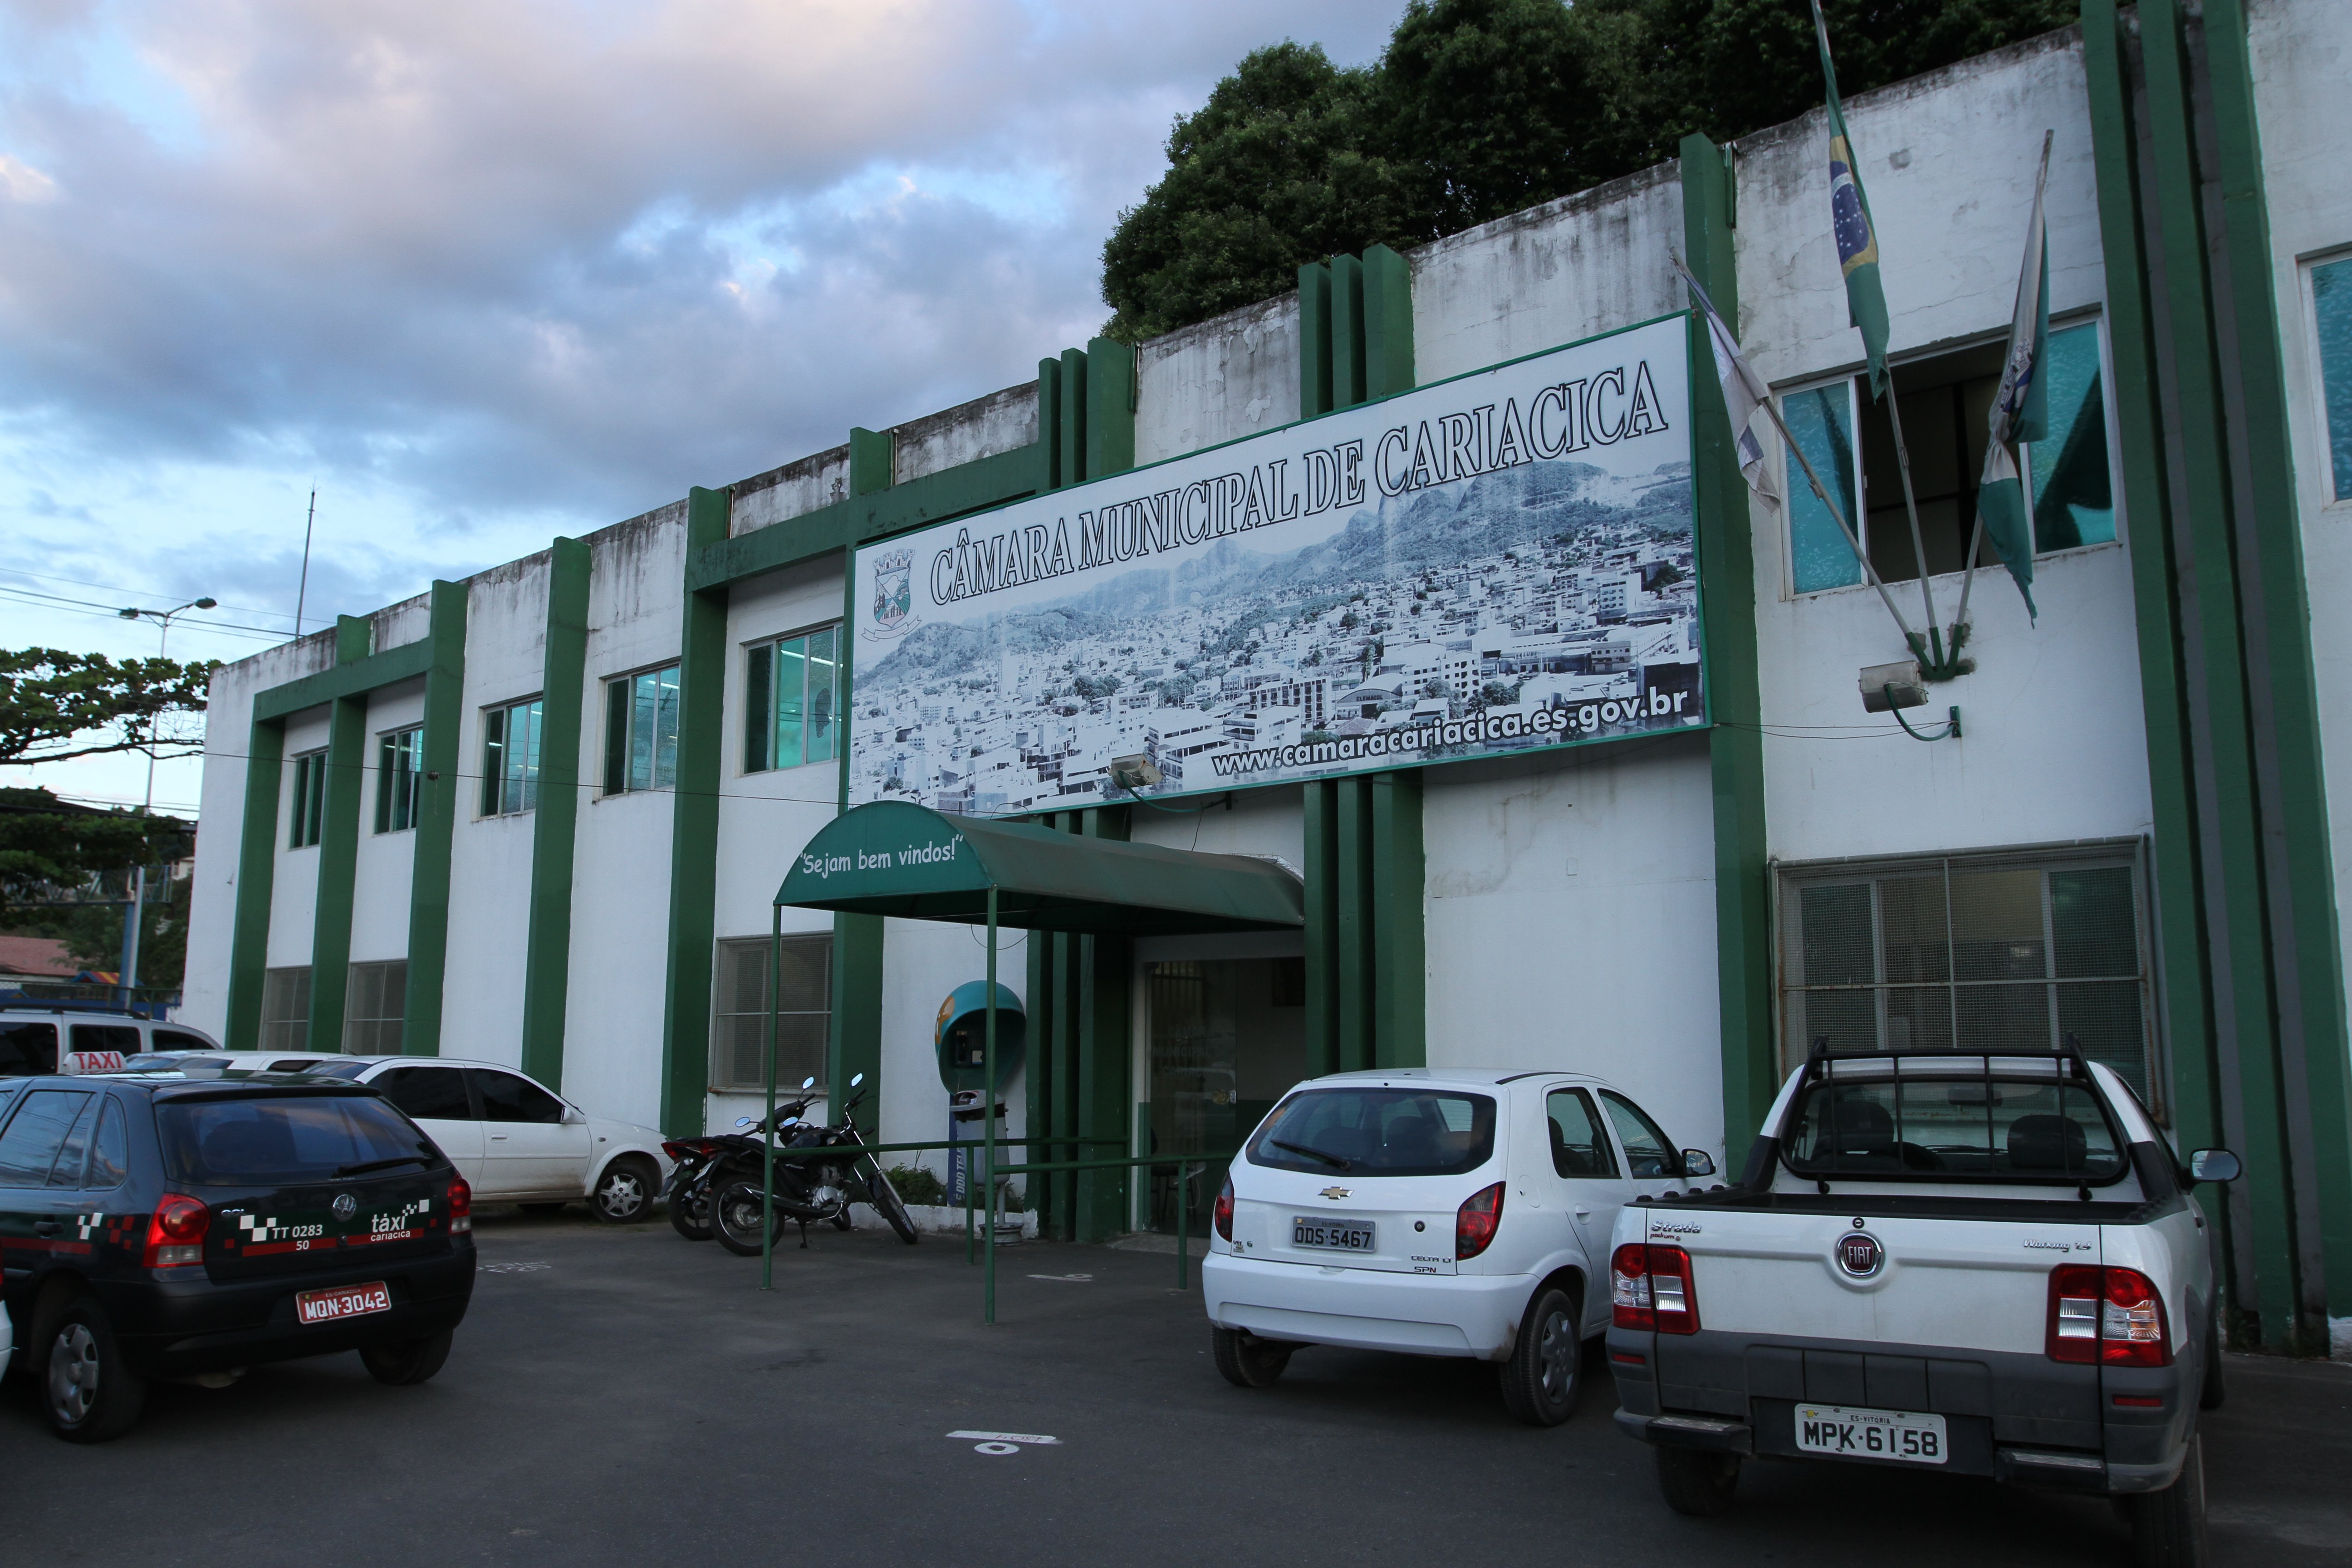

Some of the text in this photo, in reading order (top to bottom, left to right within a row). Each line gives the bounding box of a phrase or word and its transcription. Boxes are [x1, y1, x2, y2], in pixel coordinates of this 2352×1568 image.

[931, 361, 1669, 606] CÂMARA MUNICIPAL DE CARIACICA
[1212, 686, 1690, 777] www.camaracariacica.es.gov.br
[858, 849, 891, 870] bem
[73, 1052, 122, 1069] TAXI
[956, 1171, 965, 1194] DDD
[272, 1224, 323, 1239] TT 0283
[1651, 1219, 1702, 1234] Strada
[371, 1230, 411, 1242] cariacica
[296, 1240, 309, 1250] 50
[2024, 1239, 2070, 1253] Working
[1847, 1246, 1872, 1264] FIAT
